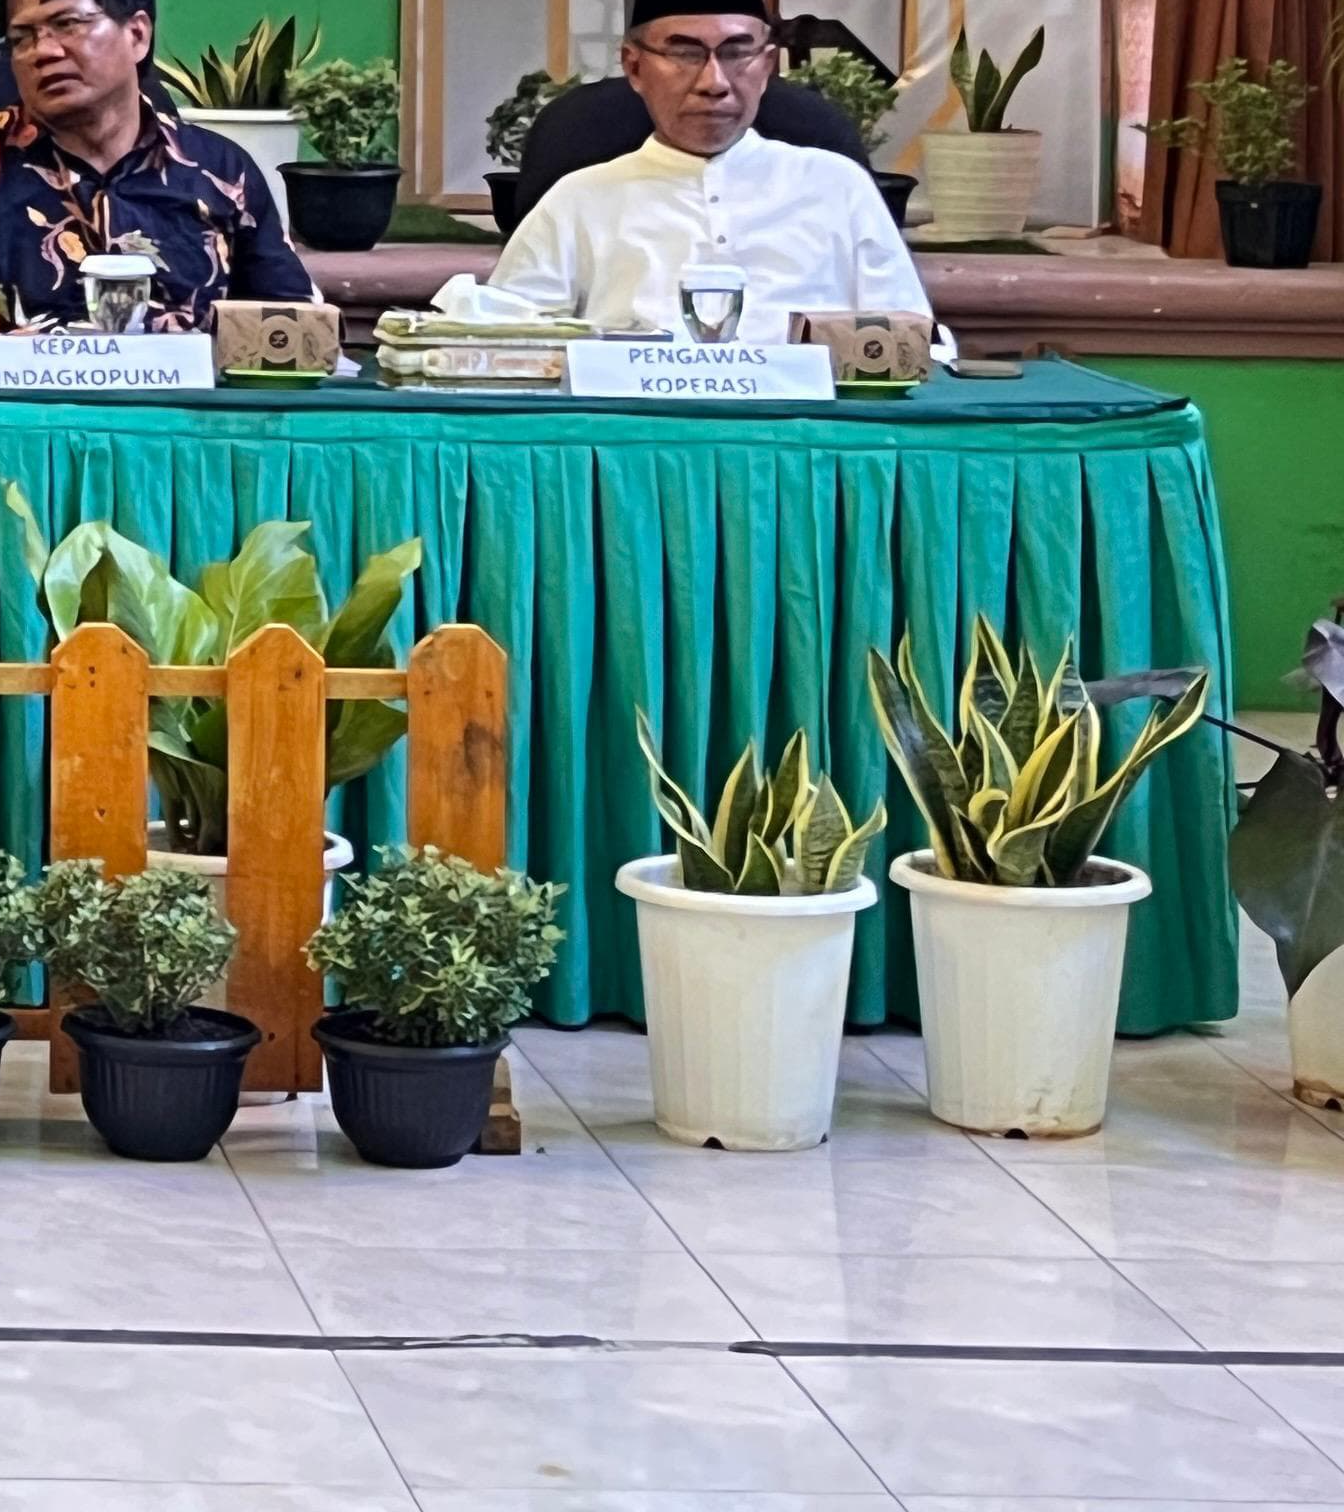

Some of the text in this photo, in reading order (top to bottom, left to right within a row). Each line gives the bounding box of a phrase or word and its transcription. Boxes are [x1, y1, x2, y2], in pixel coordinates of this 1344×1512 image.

[32, 338, 120, 354] KEPALA
[629, 348, 767, 365] PENGAWAS
[641, 378, 757, 394] KOPERASI
